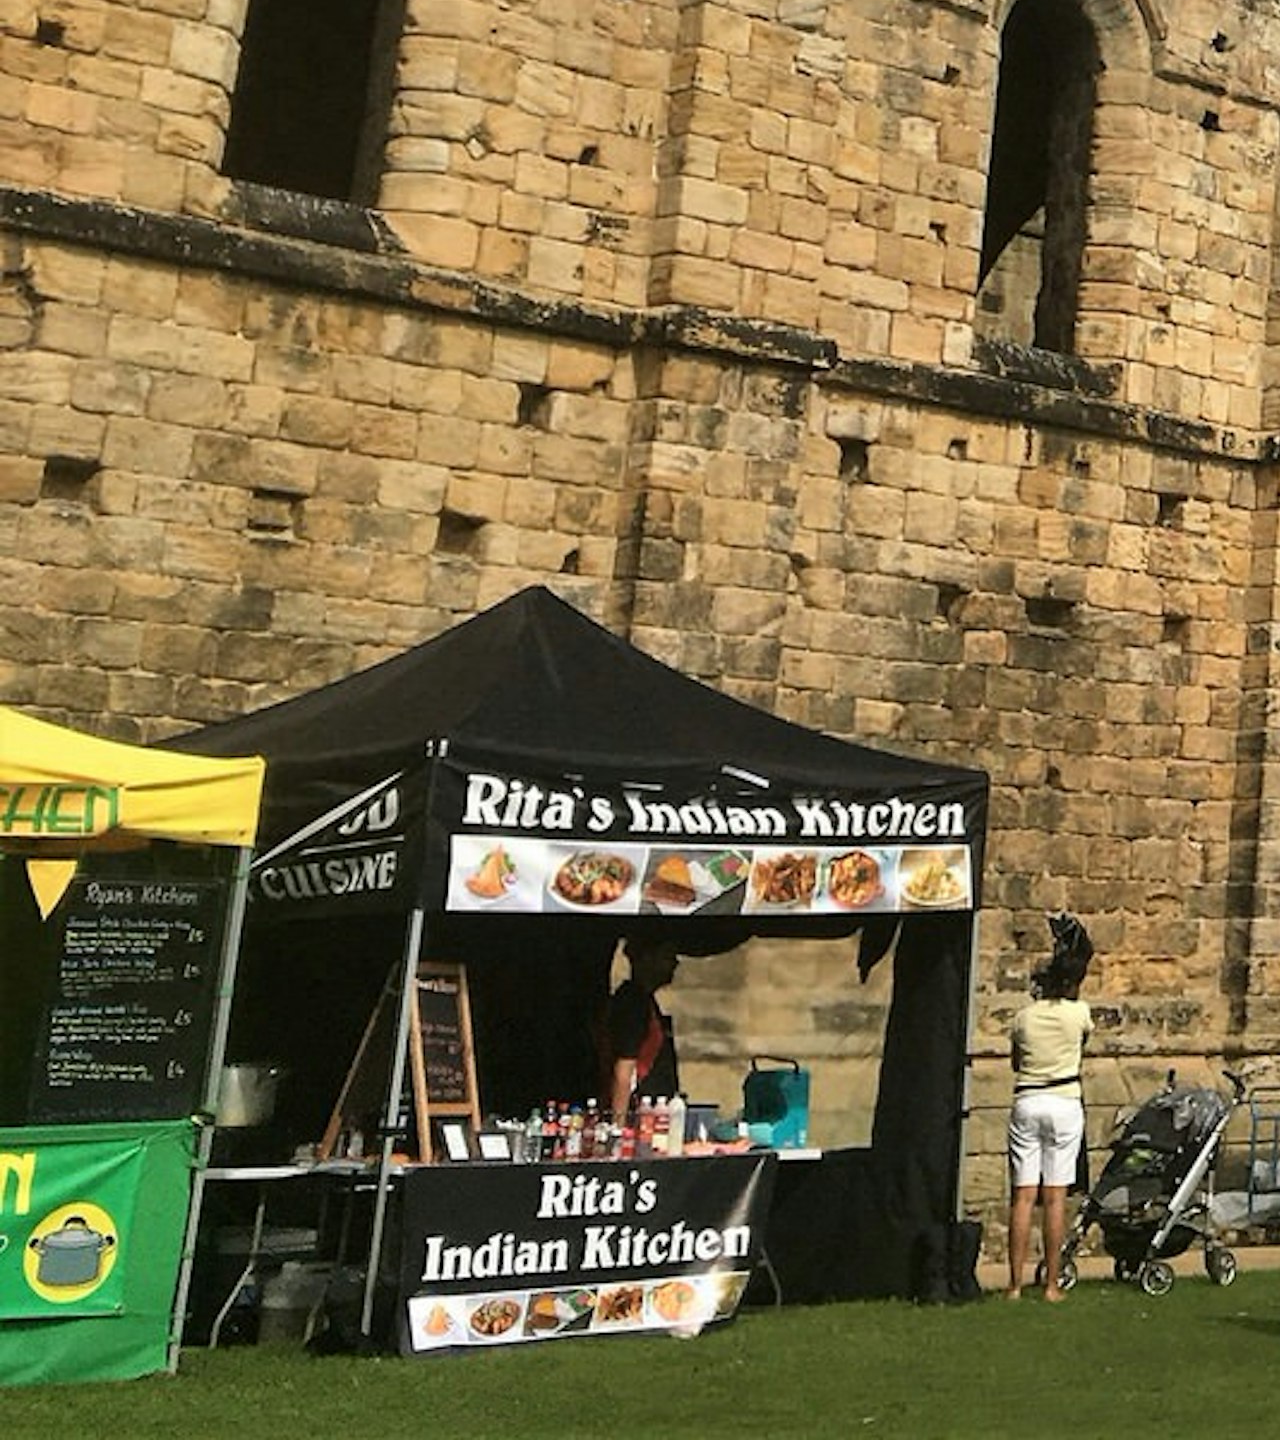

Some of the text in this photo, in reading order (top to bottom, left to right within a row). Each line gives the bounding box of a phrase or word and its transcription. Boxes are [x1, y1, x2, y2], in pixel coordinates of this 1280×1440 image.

[462, 773, 966, 838] Rita's Indian Kitchen
[86, 882, 198, 909] Ryan's Kitchen
[260, 850, 398, 901] CUISINE
[536, 1169, 658, 1219] Rita's
[421, 1220, 751, 1281] Indian Kitchen
